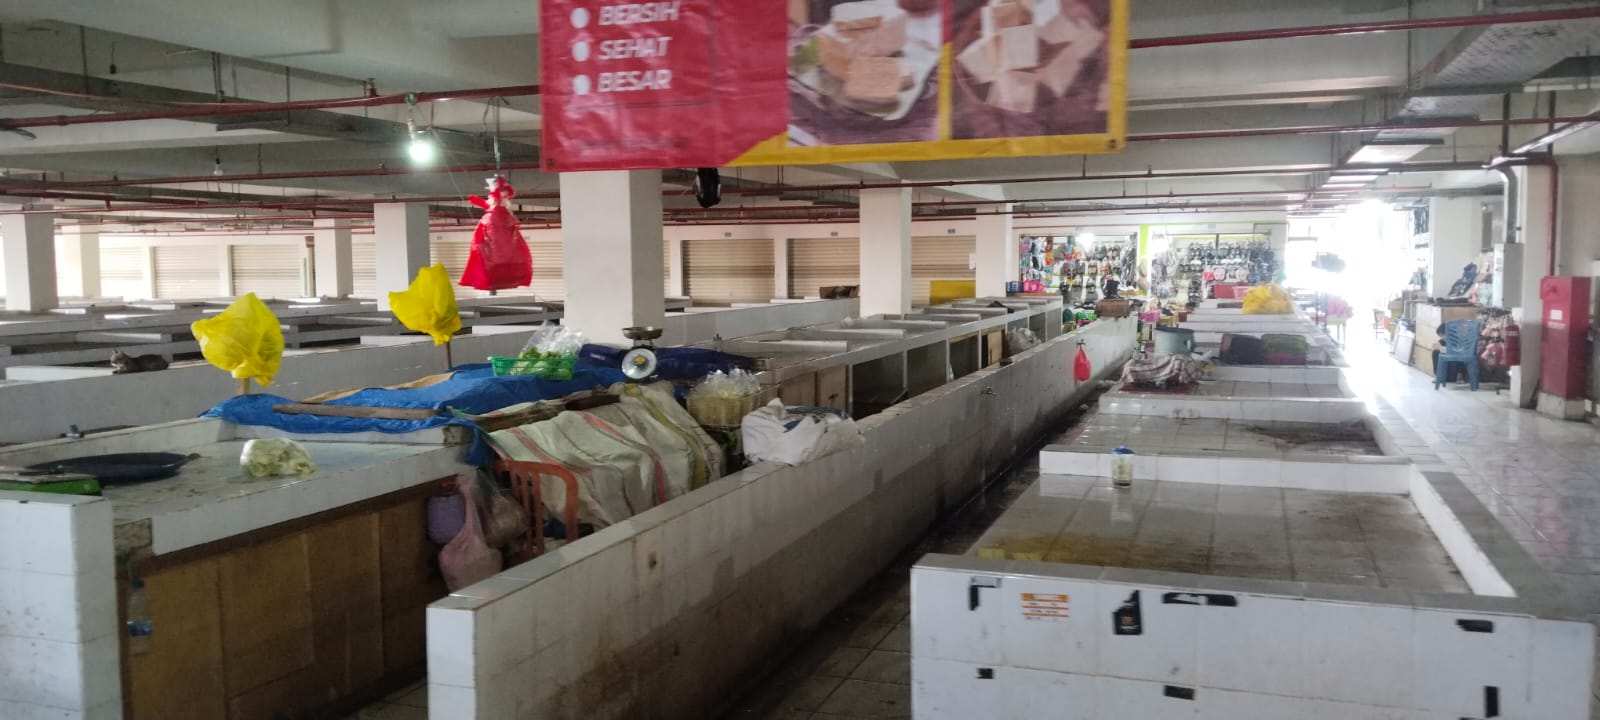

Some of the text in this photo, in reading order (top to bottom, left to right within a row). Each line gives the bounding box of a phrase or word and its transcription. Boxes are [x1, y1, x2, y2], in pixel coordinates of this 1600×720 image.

[598, 1, 681, 26] BERSIH
[598, 37, 672, 60] SEHAT
[598, 69, 673, 92] BESAR
